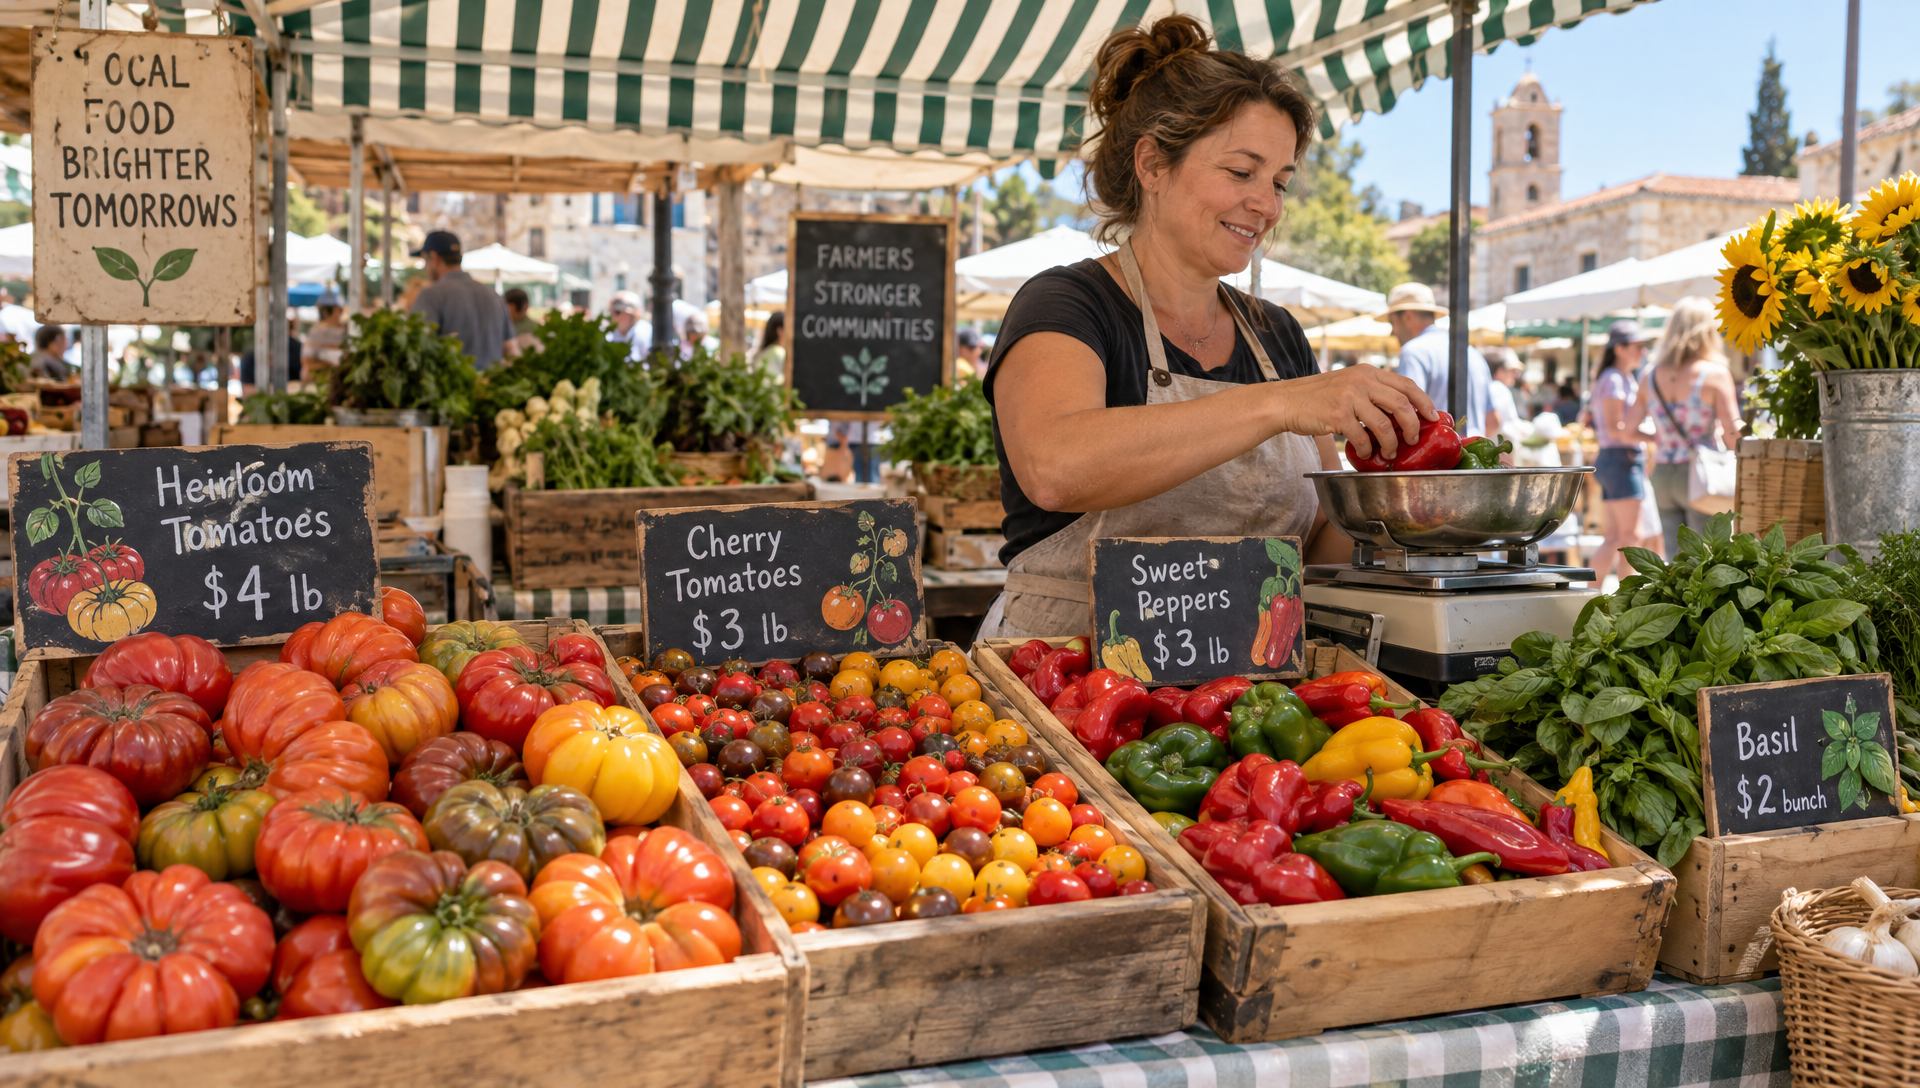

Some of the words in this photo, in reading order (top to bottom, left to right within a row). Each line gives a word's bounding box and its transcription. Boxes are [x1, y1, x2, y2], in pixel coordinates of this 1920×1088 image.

[84, 98, 174, 135] FOOD
[62, 146, 212, 181] BRIGHTER
[50, 192, 237, 228] TOMORROWS
[817, 244, 914, 271] FARMERS
[814, 280, 922, 307] STRONGER
[802, 314, 935, 342] COMMUNITIES
[156, 461, 315, 507] Heirloom
[160, 506, 332, 555] Tomatoes
[687, 524, 782, 562] Cherry
[665, 562, 802, 602] Tomatoes
[1131, 552, 1208, 586] Sweet
[203, 564, 271, 621] $4
[290, 573, 323, 614] lb
[1137, 589, 1231, 623] Peppers
[692, 608, 744, 656] $3
[762, 611, 788, 645] lb
[1153, 628, 1197, 671] $3
[1208, 636, 1230, 665] lb
[1736, 715, 1798, 761] Basil
[1737, 774, 1776, 820] $2
[1782, 785, 1828, 814] bunch
